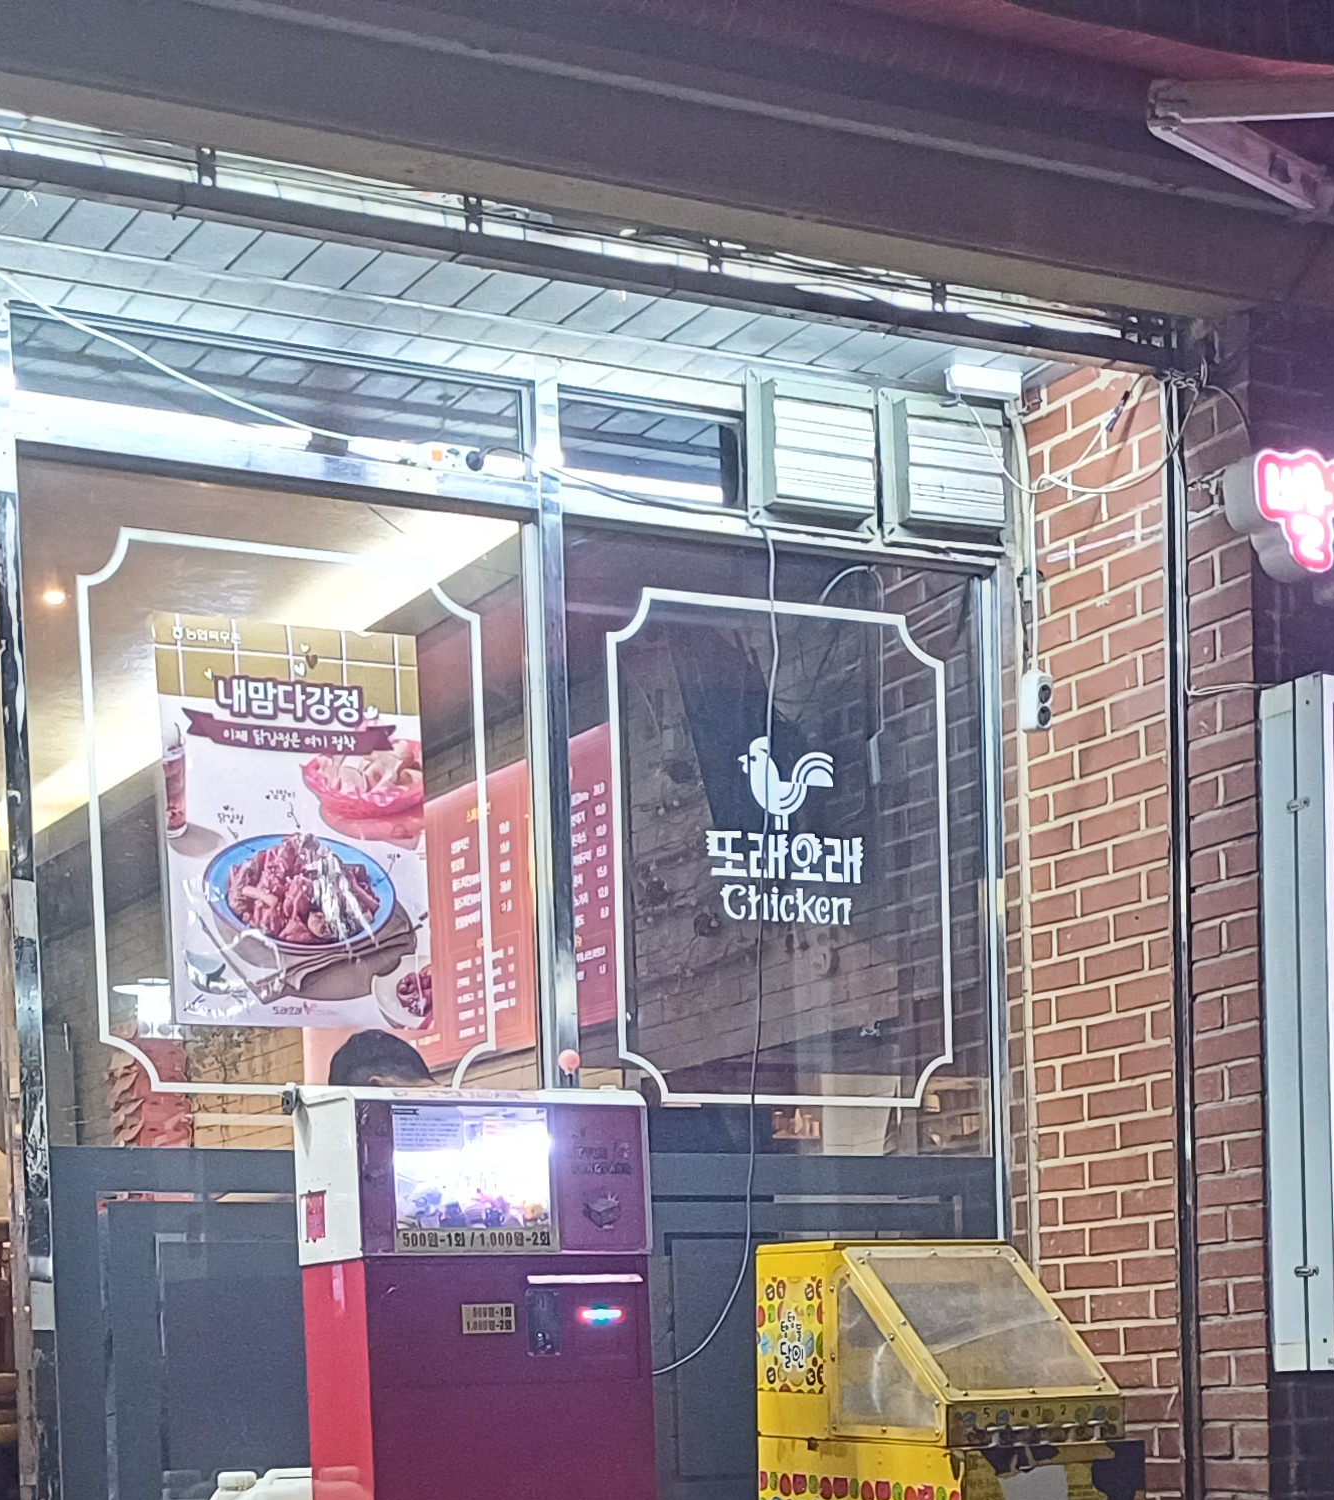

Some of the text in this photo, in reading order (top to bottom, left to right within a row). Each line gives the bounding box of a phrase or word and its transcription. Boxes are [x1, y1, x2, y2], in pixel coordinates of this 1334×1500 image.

[223, 728, 248, 743] 이제
[304, 734, 328, 748] 여기
[705, 830, 864, 884] 또래오래
[719, 883, 853, 926] Chicken
